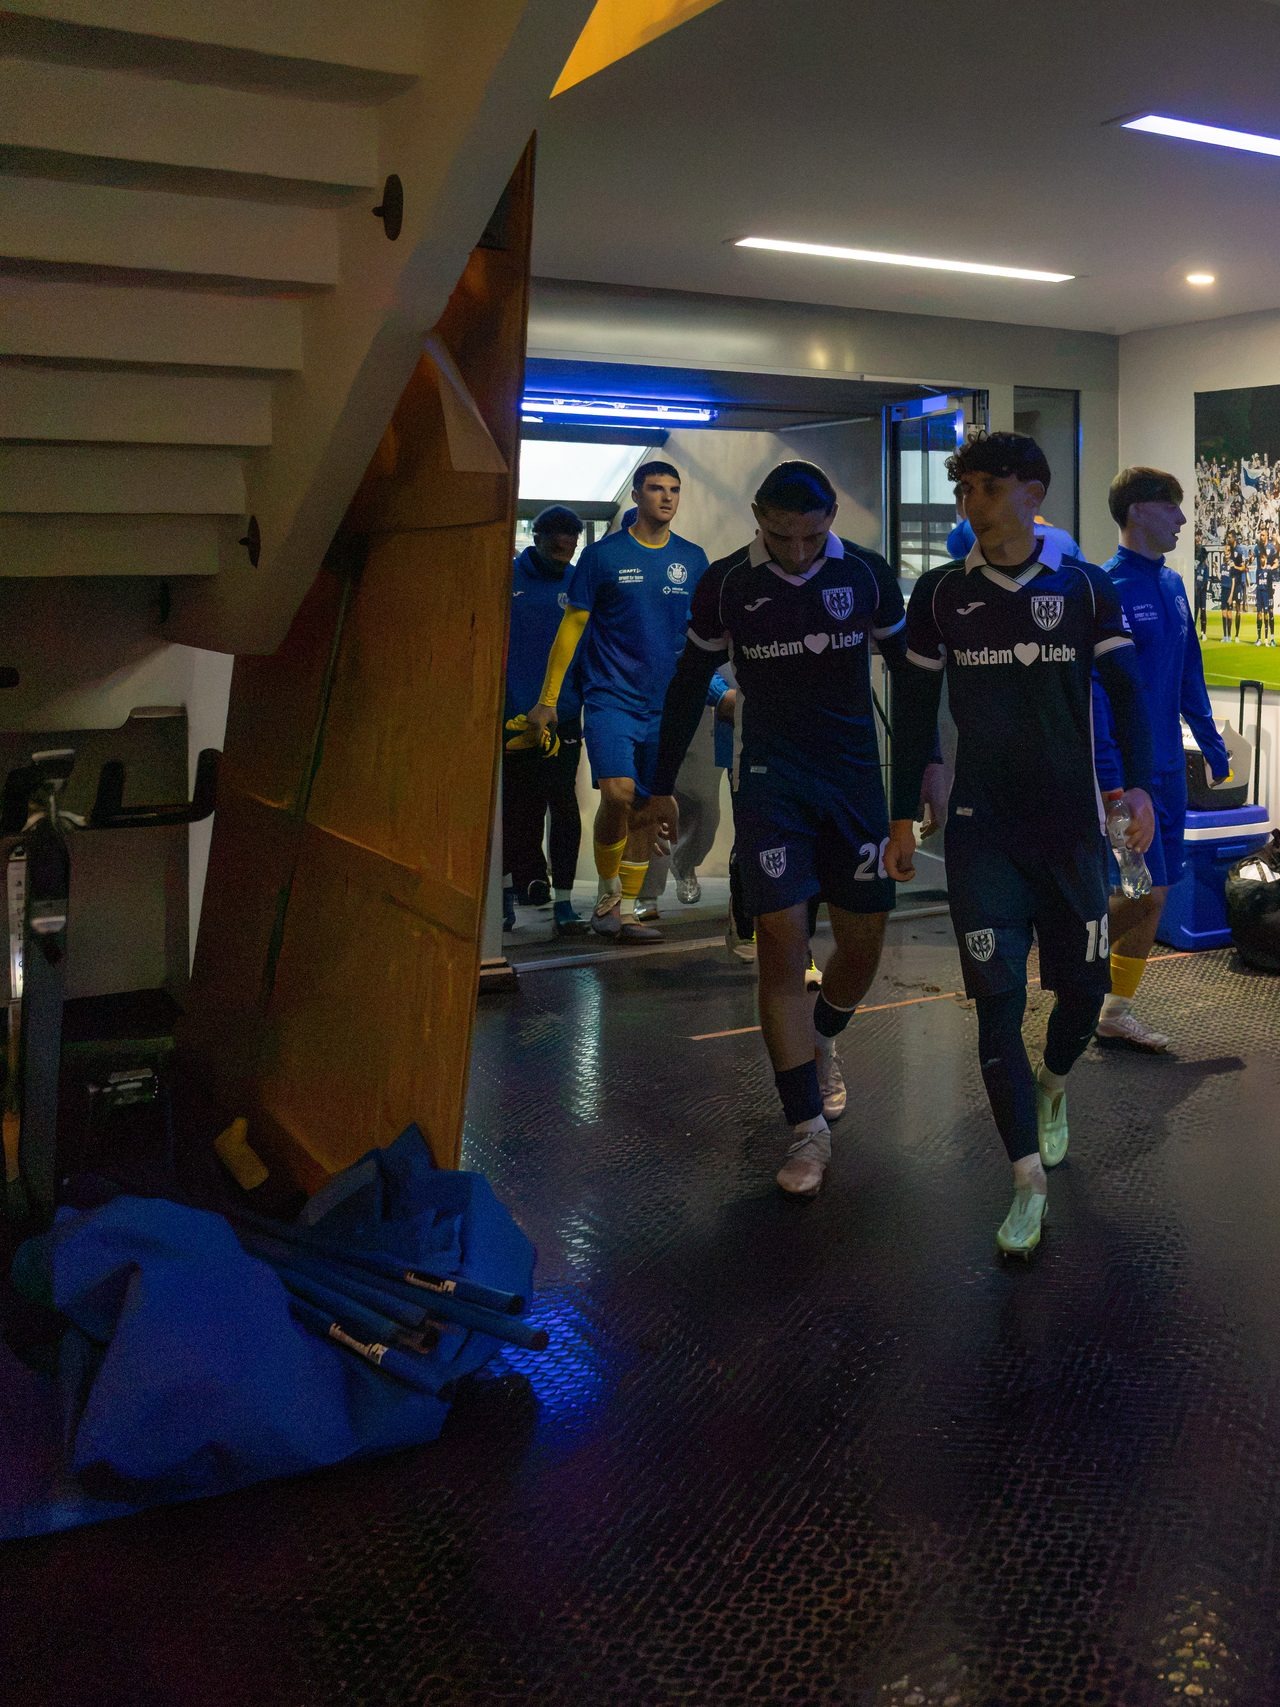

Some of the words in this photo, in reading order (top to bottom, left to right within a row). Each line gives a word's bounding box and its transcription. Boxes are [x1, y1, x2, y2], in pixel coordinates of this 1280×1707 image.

[831, 631, 864, 650] Liebe
[953, 647, 1013, 666] Potsdam
[1041, 643, 1076, 662] Liebe
[1085, 913, 1109, 962] 18
